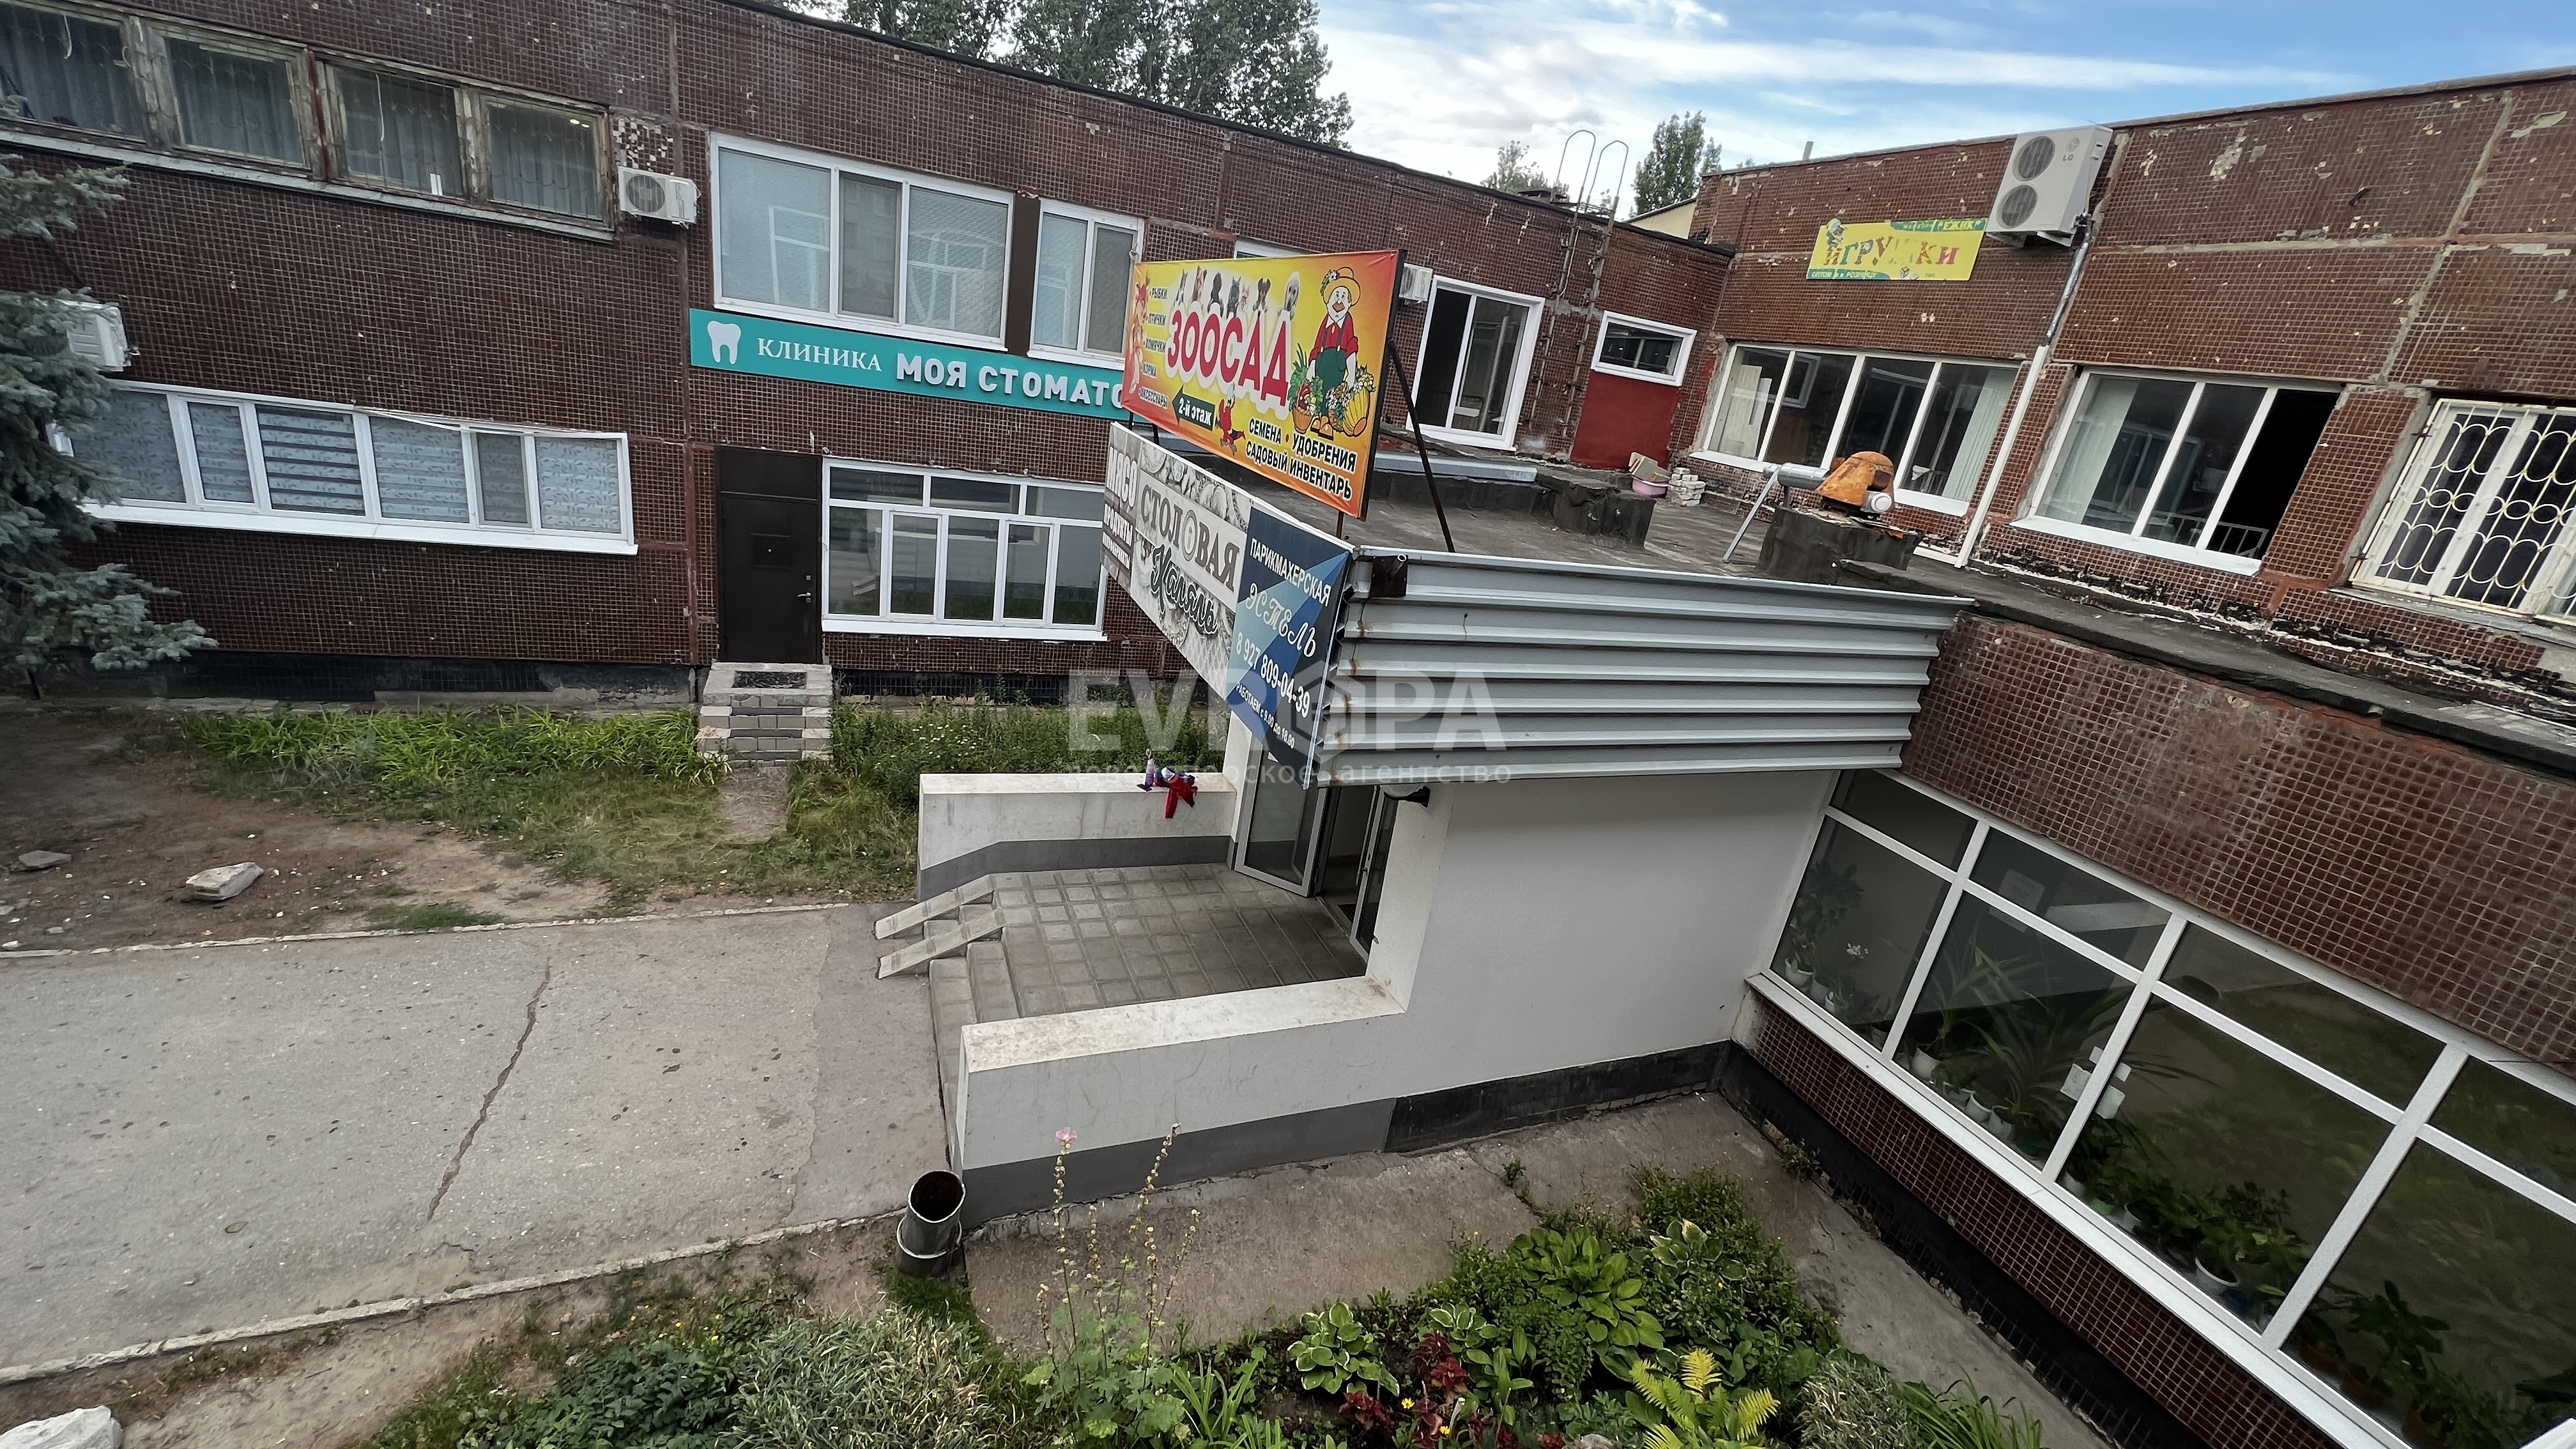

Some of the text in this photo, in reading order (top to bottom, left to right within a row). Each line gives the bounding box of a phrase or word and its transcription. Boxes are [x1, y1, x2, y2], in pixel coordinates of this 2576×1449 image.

[1823, 236, 1959, 266] ИГРУКИ
[1148, 313, 1166, 326] ПТИЧКИ
[1151, 288, 1167, 299] РЫБКИ
[757, 338, 1123, 409] КЛИНИКА МОЯ СТОМАТО
[1143, 362, 1157, 378] КОРМА
[1168, 310, 1289, 407] ЗООСАД
[1140, 387, 1168, 410] АКСЕССУАРЫ
[1178, 397, 1212, 426] 2-й этаж
[1246, 441, 1351, 499] САДОВЫЙ ИНВЕНТАРЬ
[1250, 418, 1356, 472] СЕМЕНА УДОБРЕНИЯ
[1106, 447, 1138, 507] МЯСО
[1104, 503, 1133, 547] ПРОДУКТЫ
[1141, 484, 1239, 592] СТОЛОВАЯ
[1250, 538, 1331, 607] ПАРИКМАХЕРСКАЯ
[1236, 632, 1310, 718] 8 927 809-04-39
[1236, 683, 1261, 714] РАБОТАЕМ
[1264, 710, 1274, 728] 9.00
[1273, 723, 1280, 735] до
[1282, 728, 1295, 749] 18.00
